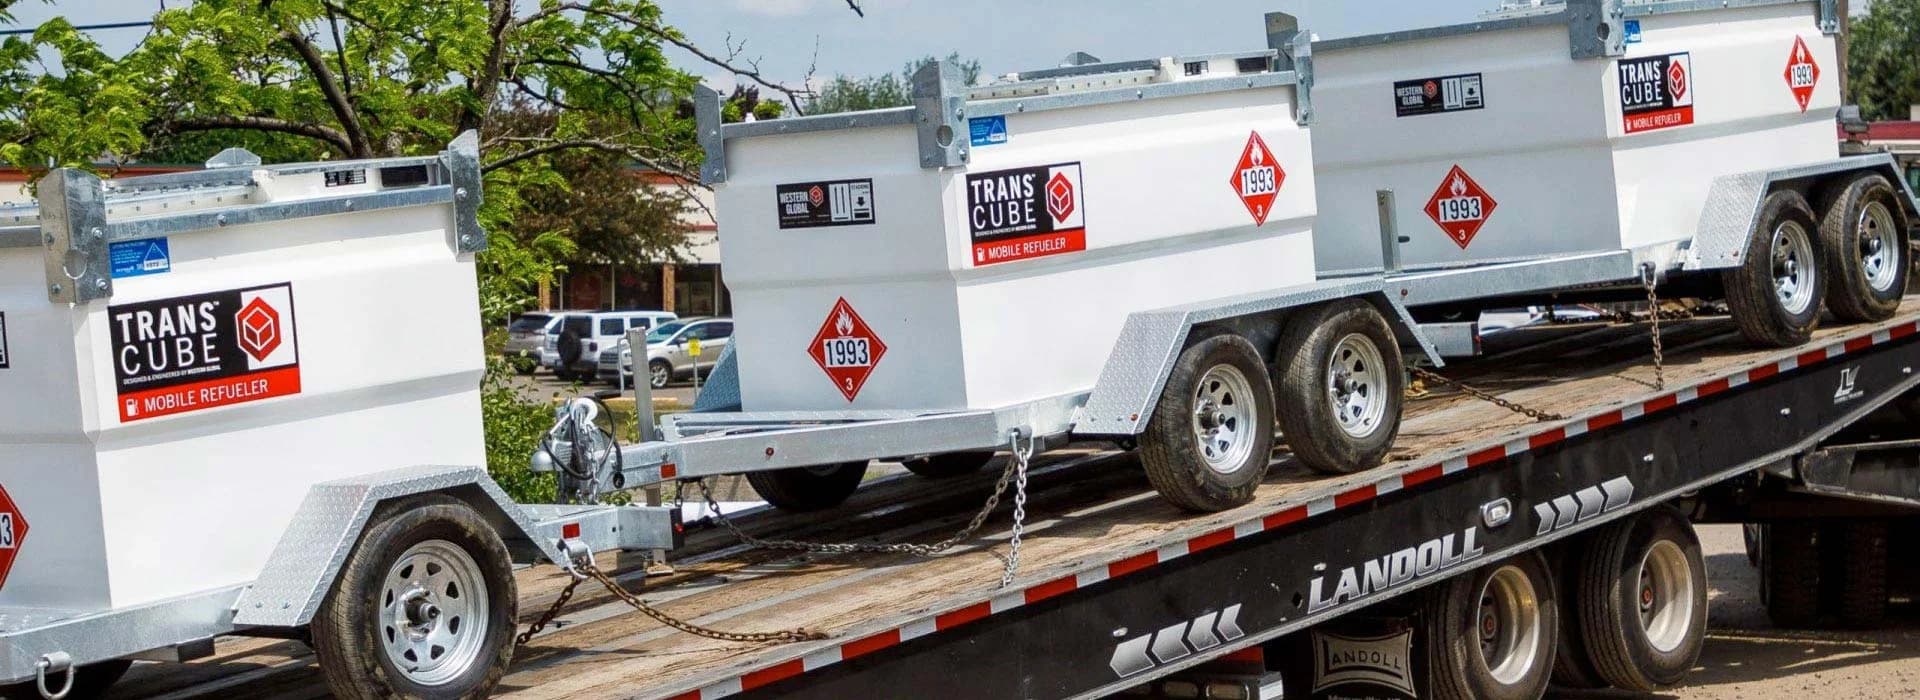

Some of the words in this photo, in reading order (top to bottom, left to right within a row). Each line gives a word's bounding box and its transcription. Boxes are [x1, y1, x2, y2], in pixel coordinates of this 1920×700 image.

[1792, 65, 1812, 86] 1993
[1622, 81, 1663, 105] CUBE
[1633, 116, 1654, 129] MOBILE
[1243, 168, 1274, 194] 1993
[779, 191, 809, 203] WESTERN
[785, 203, 810, 215] GLOBAL
[973, 199, 1037, 229] CUBE
[1257, 204, 1263, 217] 3
[1440, 198, 1480, 220] 1993
[1459, 229, 1466, 241] 3
[988, 243, 1021, 260] MOBILE
[1024, 237, 1066, 254] REFUELER
[121, 332, 221, 375] CUBE
[825, 339, 868, 366] 1993
[845, 377, 854, 391] 3
[144, 392, 196, 413] MOBILE
[200, 378, 269, 403] REFUELER
[1307, 526, 1484, 615] LANDOLL
